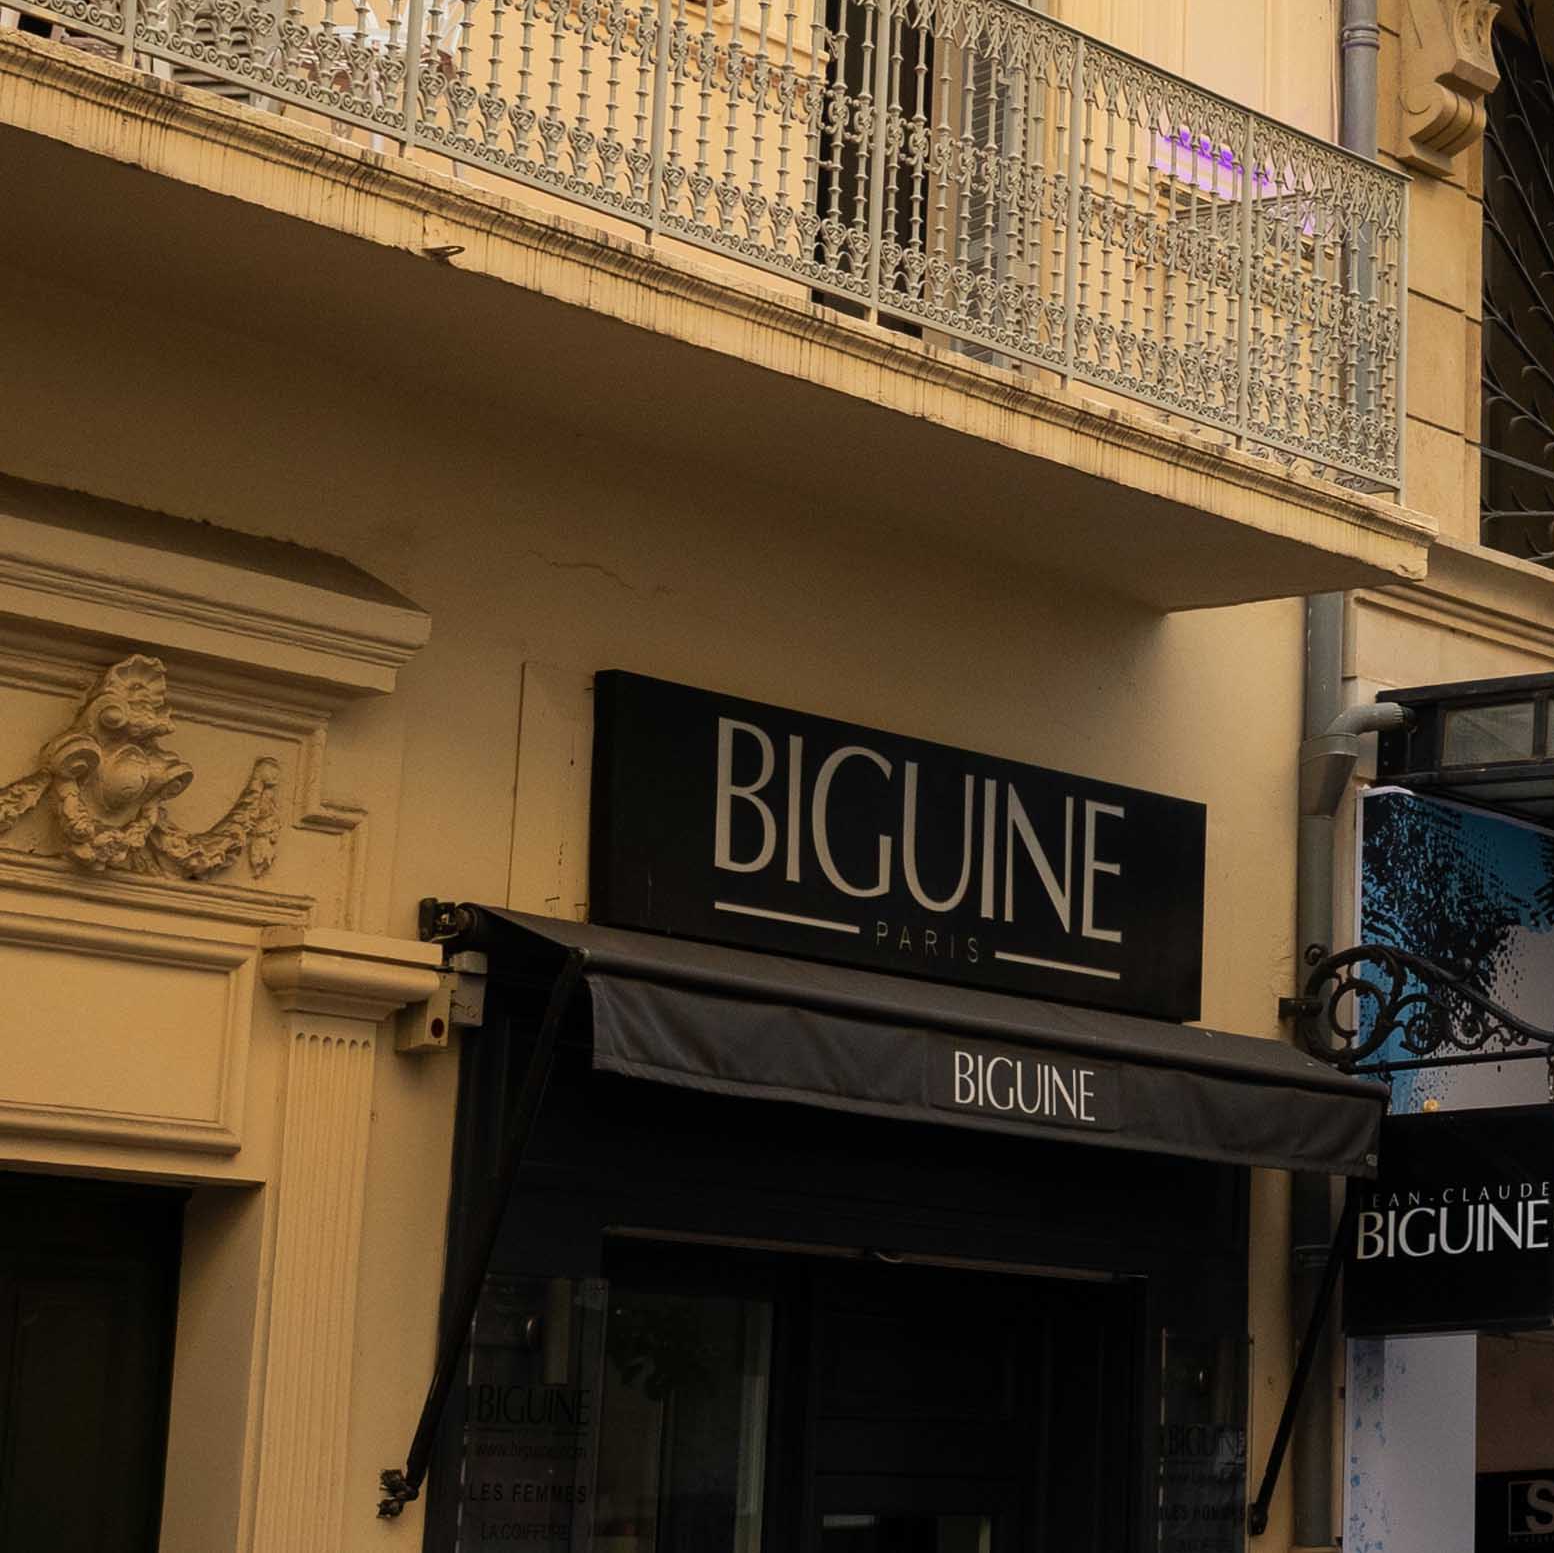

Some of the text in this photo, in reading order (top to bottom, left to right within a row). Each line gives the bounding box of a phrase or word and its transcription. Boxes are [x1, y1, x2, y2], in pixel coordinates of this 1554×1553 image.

[714, 717, 1125, 943] BIGUINE
[876, 920, 979, 964] PARIS
[954, 1051, 1096, 1122] BIGUINE
[1362, 1181, 1552, 1208] EAN-CLAUDE
[1356, 1199, 1551, 1261] BIGUINE
[478, 1384, 591, 1424] BIGUINE
[470, 1484, 587, 1504] LES FEMMES
